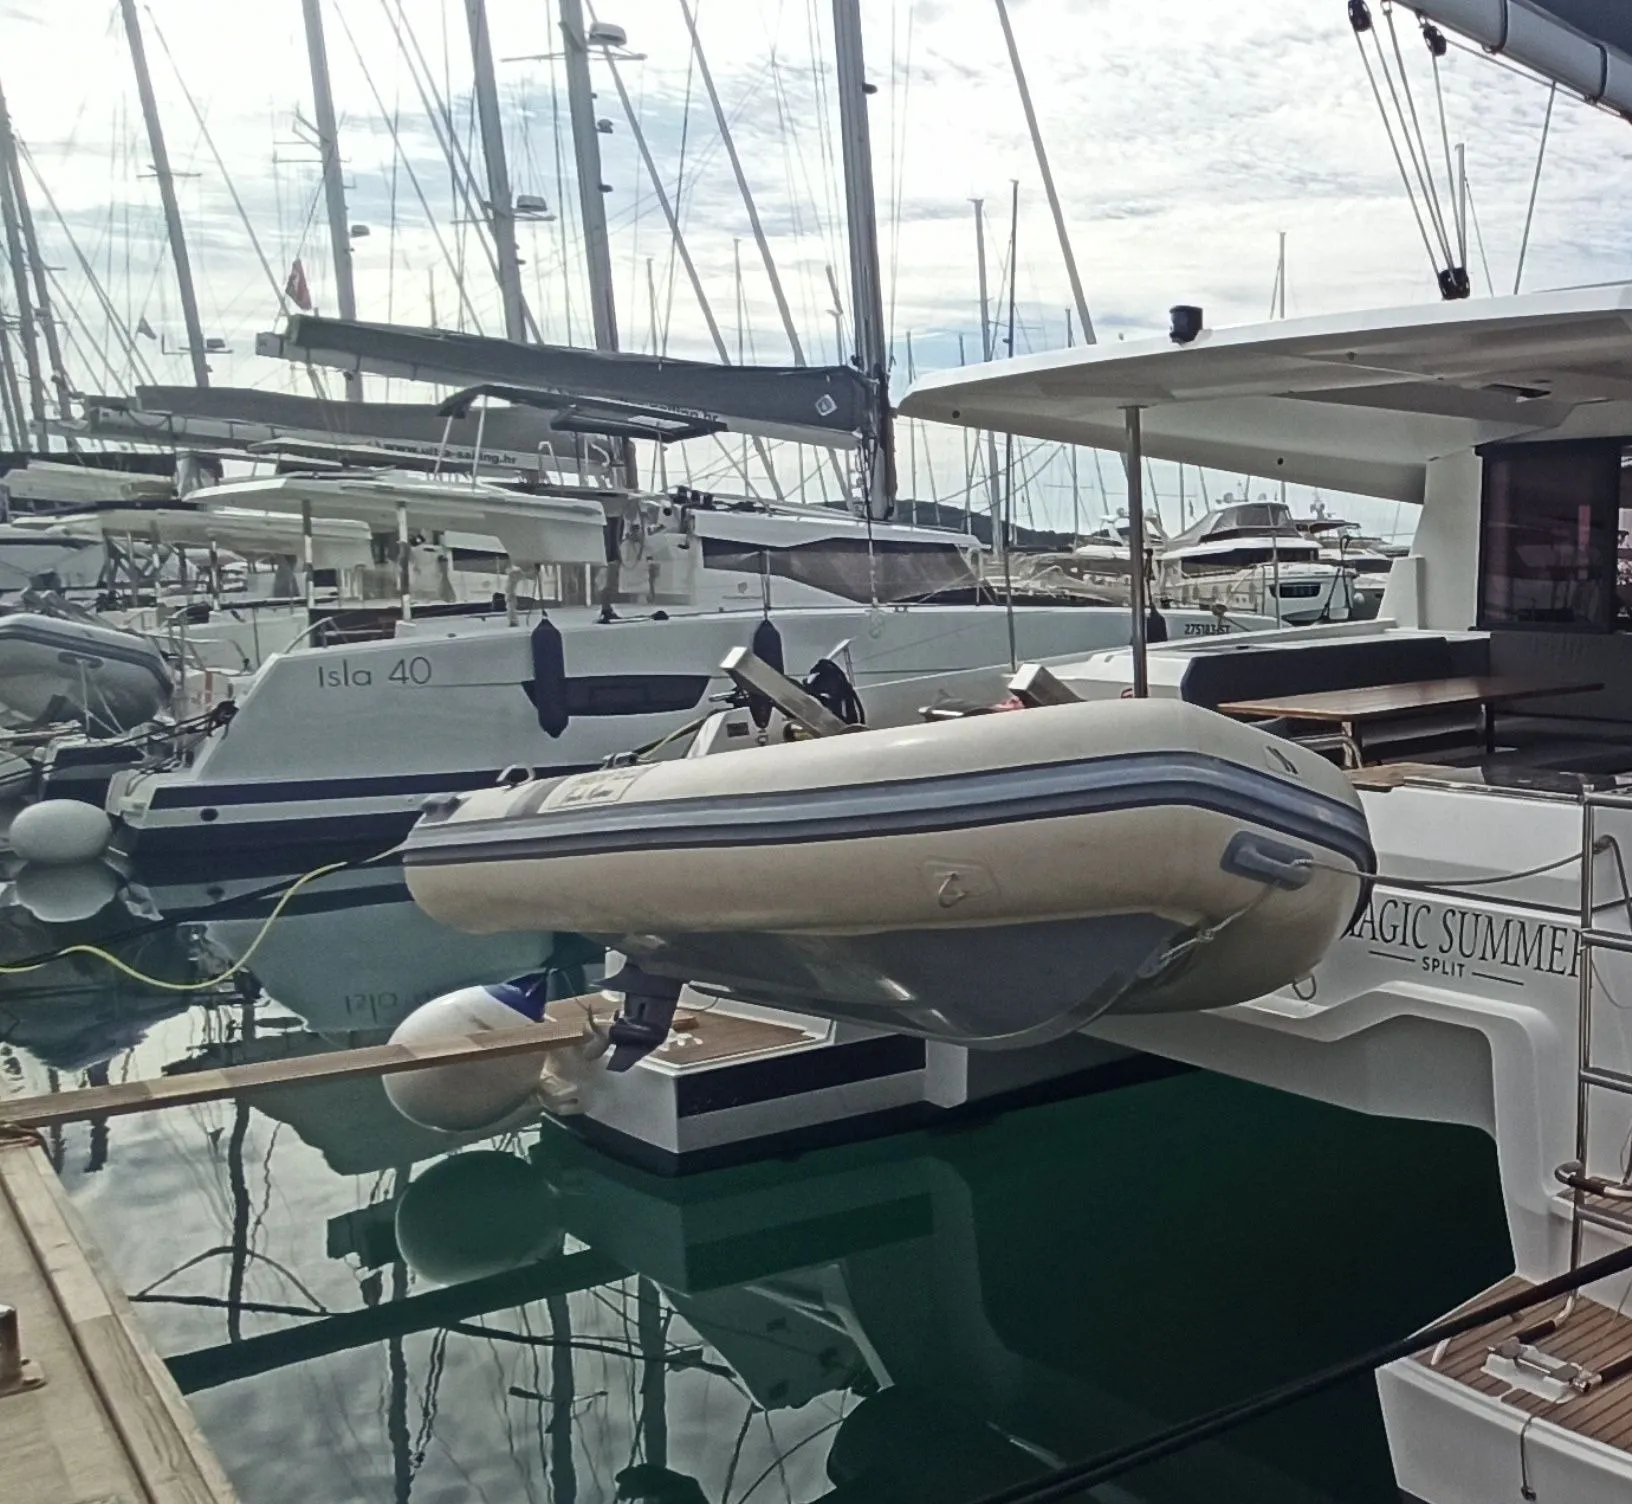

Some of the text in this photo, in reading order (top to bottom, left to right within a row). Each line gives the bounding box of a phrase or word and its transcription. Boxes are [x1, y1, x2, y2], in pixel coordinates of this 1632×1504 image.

[383, 441, 517, 465] www.ulta-saiing.hr
[318, 655, 432, 688] Isla 40
[1348, 898, 1432, 950] AGIC
[1421, 955, 1466, 979] SPLIT
